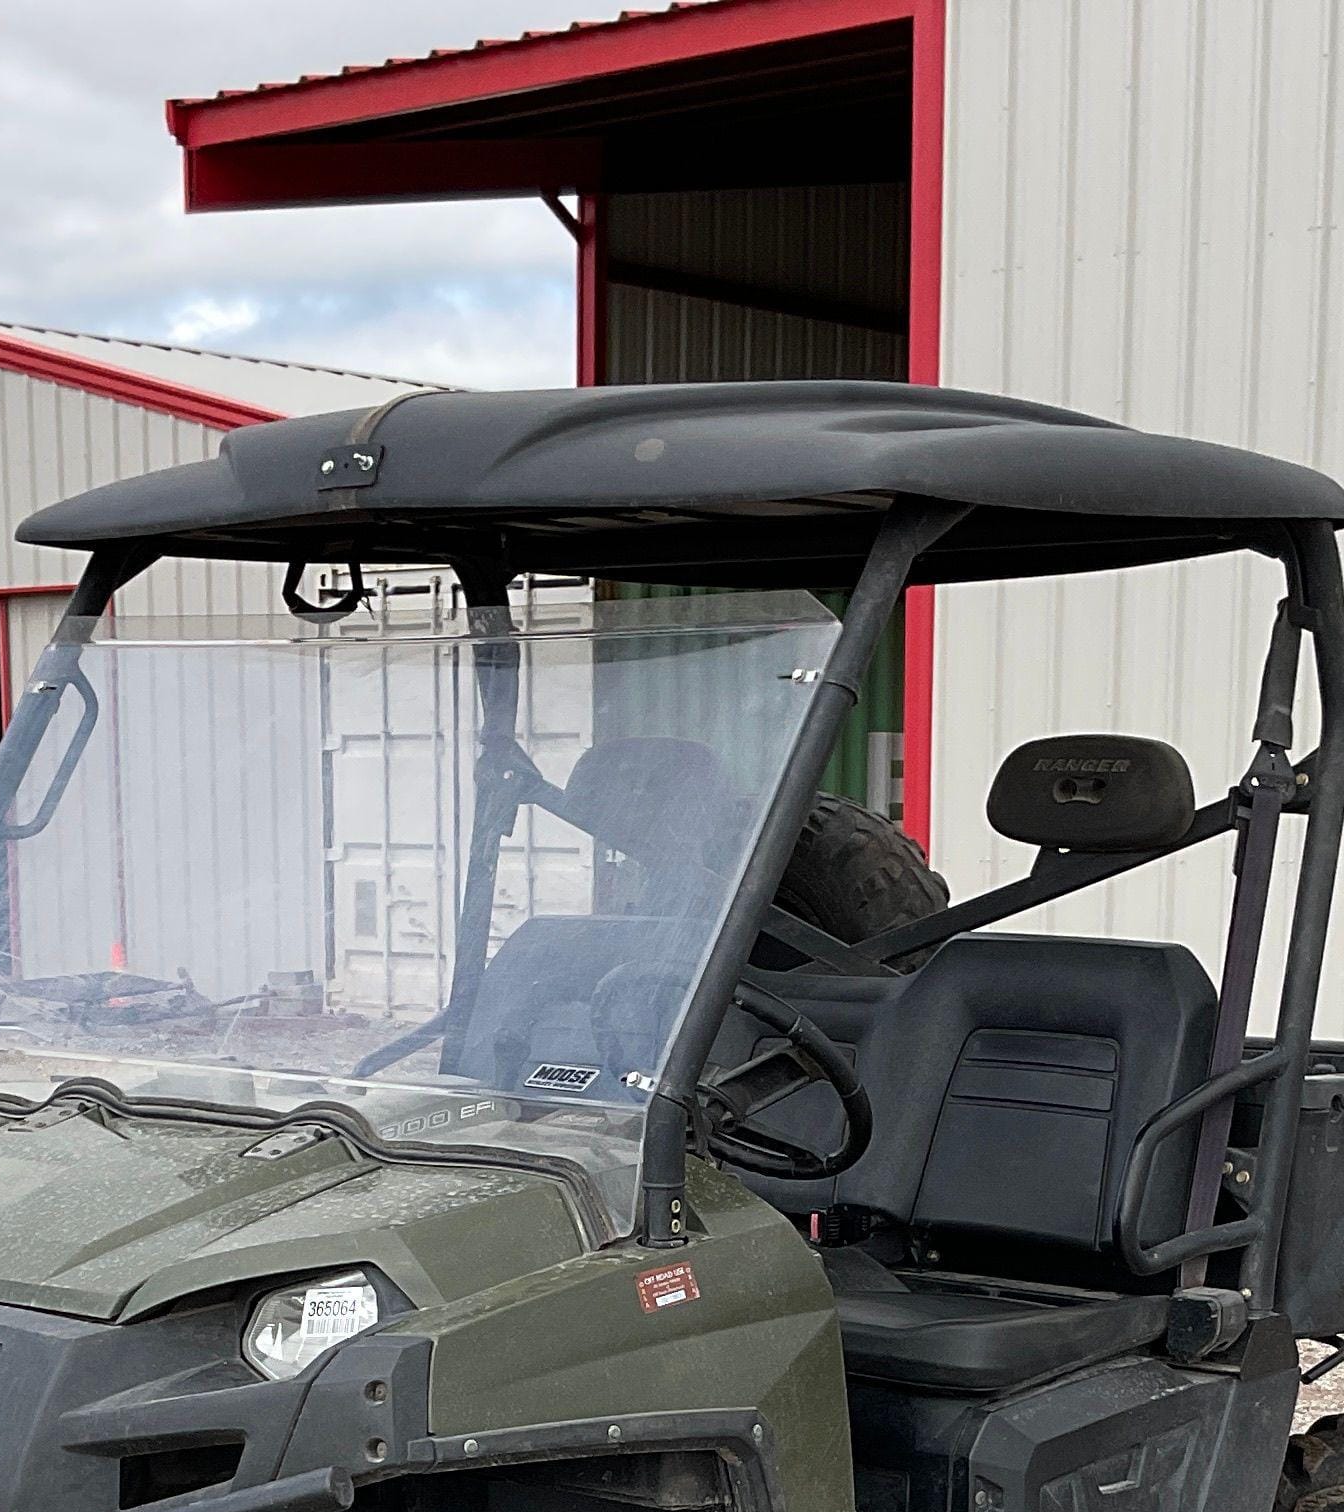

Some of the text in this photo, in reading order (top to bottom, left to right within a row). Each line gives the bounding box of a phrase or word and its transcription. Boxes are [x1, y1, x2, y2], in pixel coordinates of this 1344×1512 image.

[1033, 758, 1131, 773] RANGER
[533, 1065, 597, 1084] MOOSE
[460, 1100, 496, 1119] EFI
[308, 1299, 357, 1317] 365064
